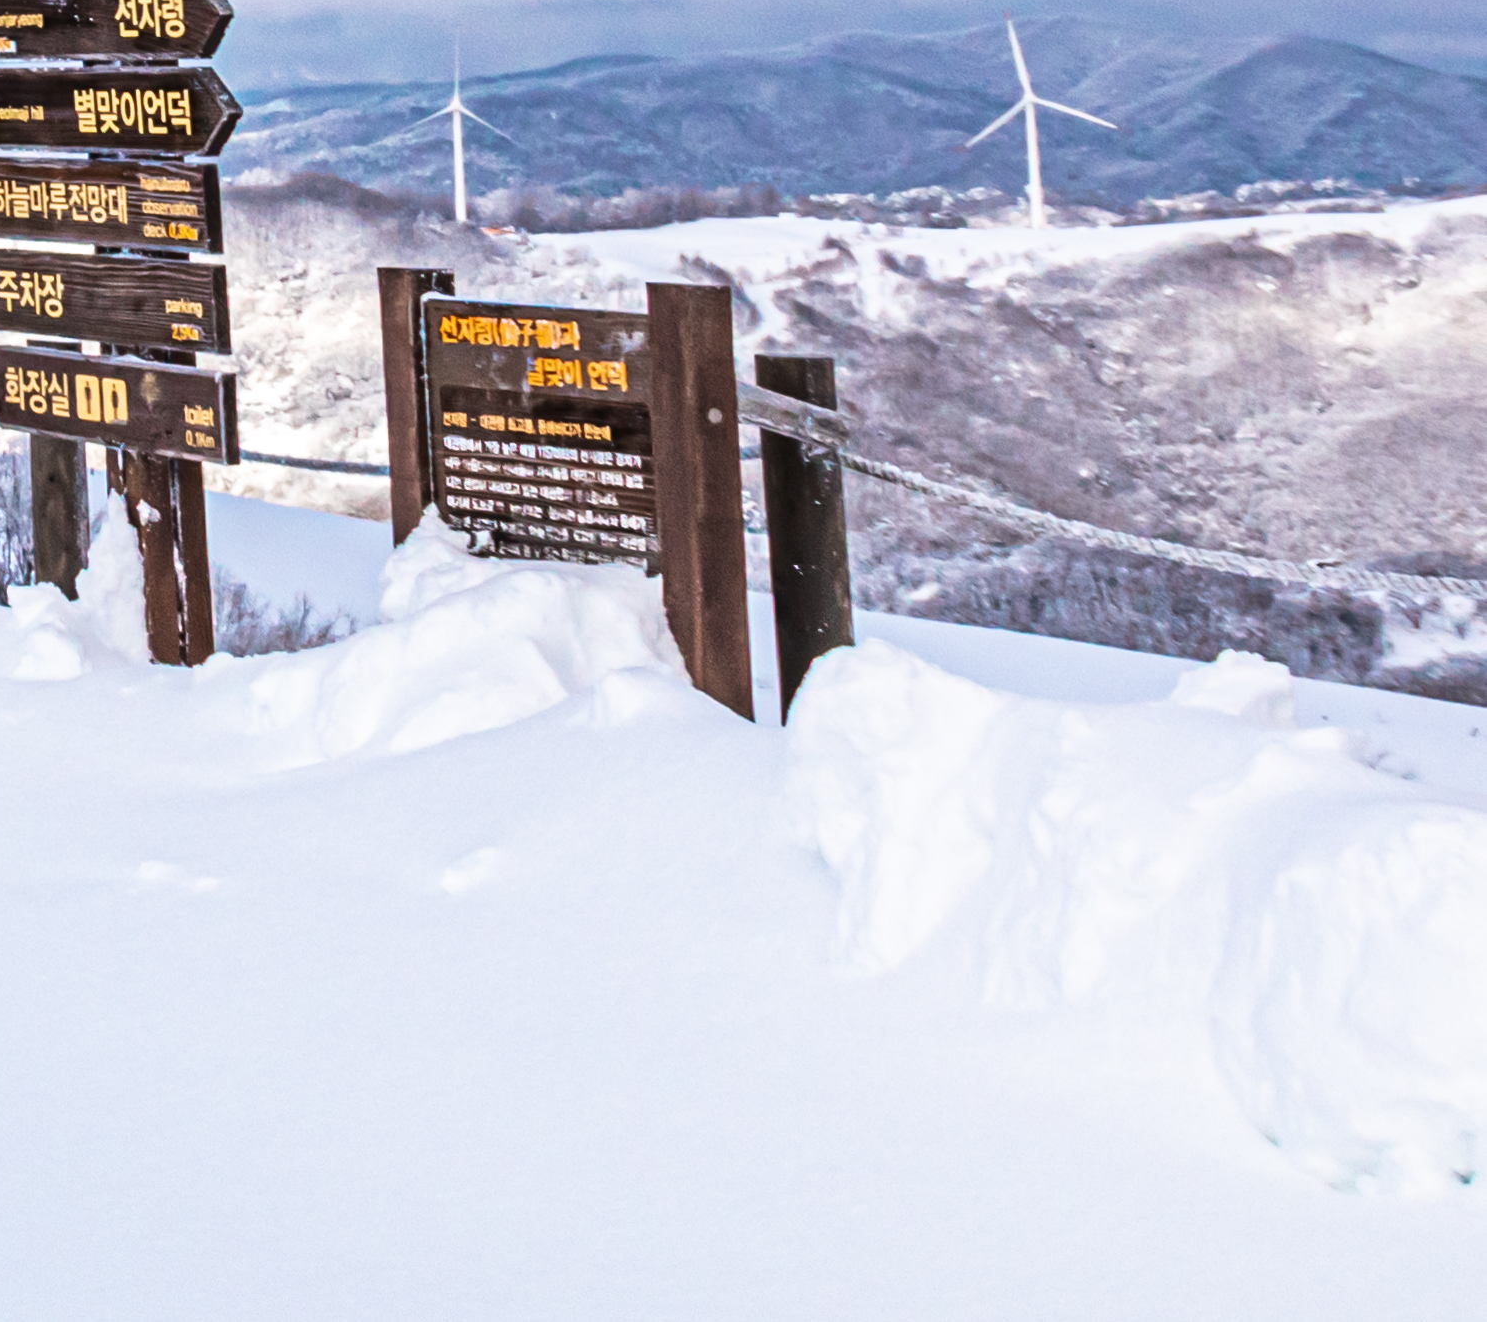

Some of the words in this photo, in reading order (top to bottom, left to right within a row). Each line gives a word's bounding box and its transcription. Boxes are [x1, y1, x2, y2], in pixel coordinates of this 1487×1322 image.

[73, 88, 192, 136] 별맞이언덕
[143, 221, 168, 238] deck
[165, 296, 203, 318] parking
[587, 360, 628, 393] 언덕
[5, 367, 71, 417] 화장실
[184, 404, 215, 427] toilet
